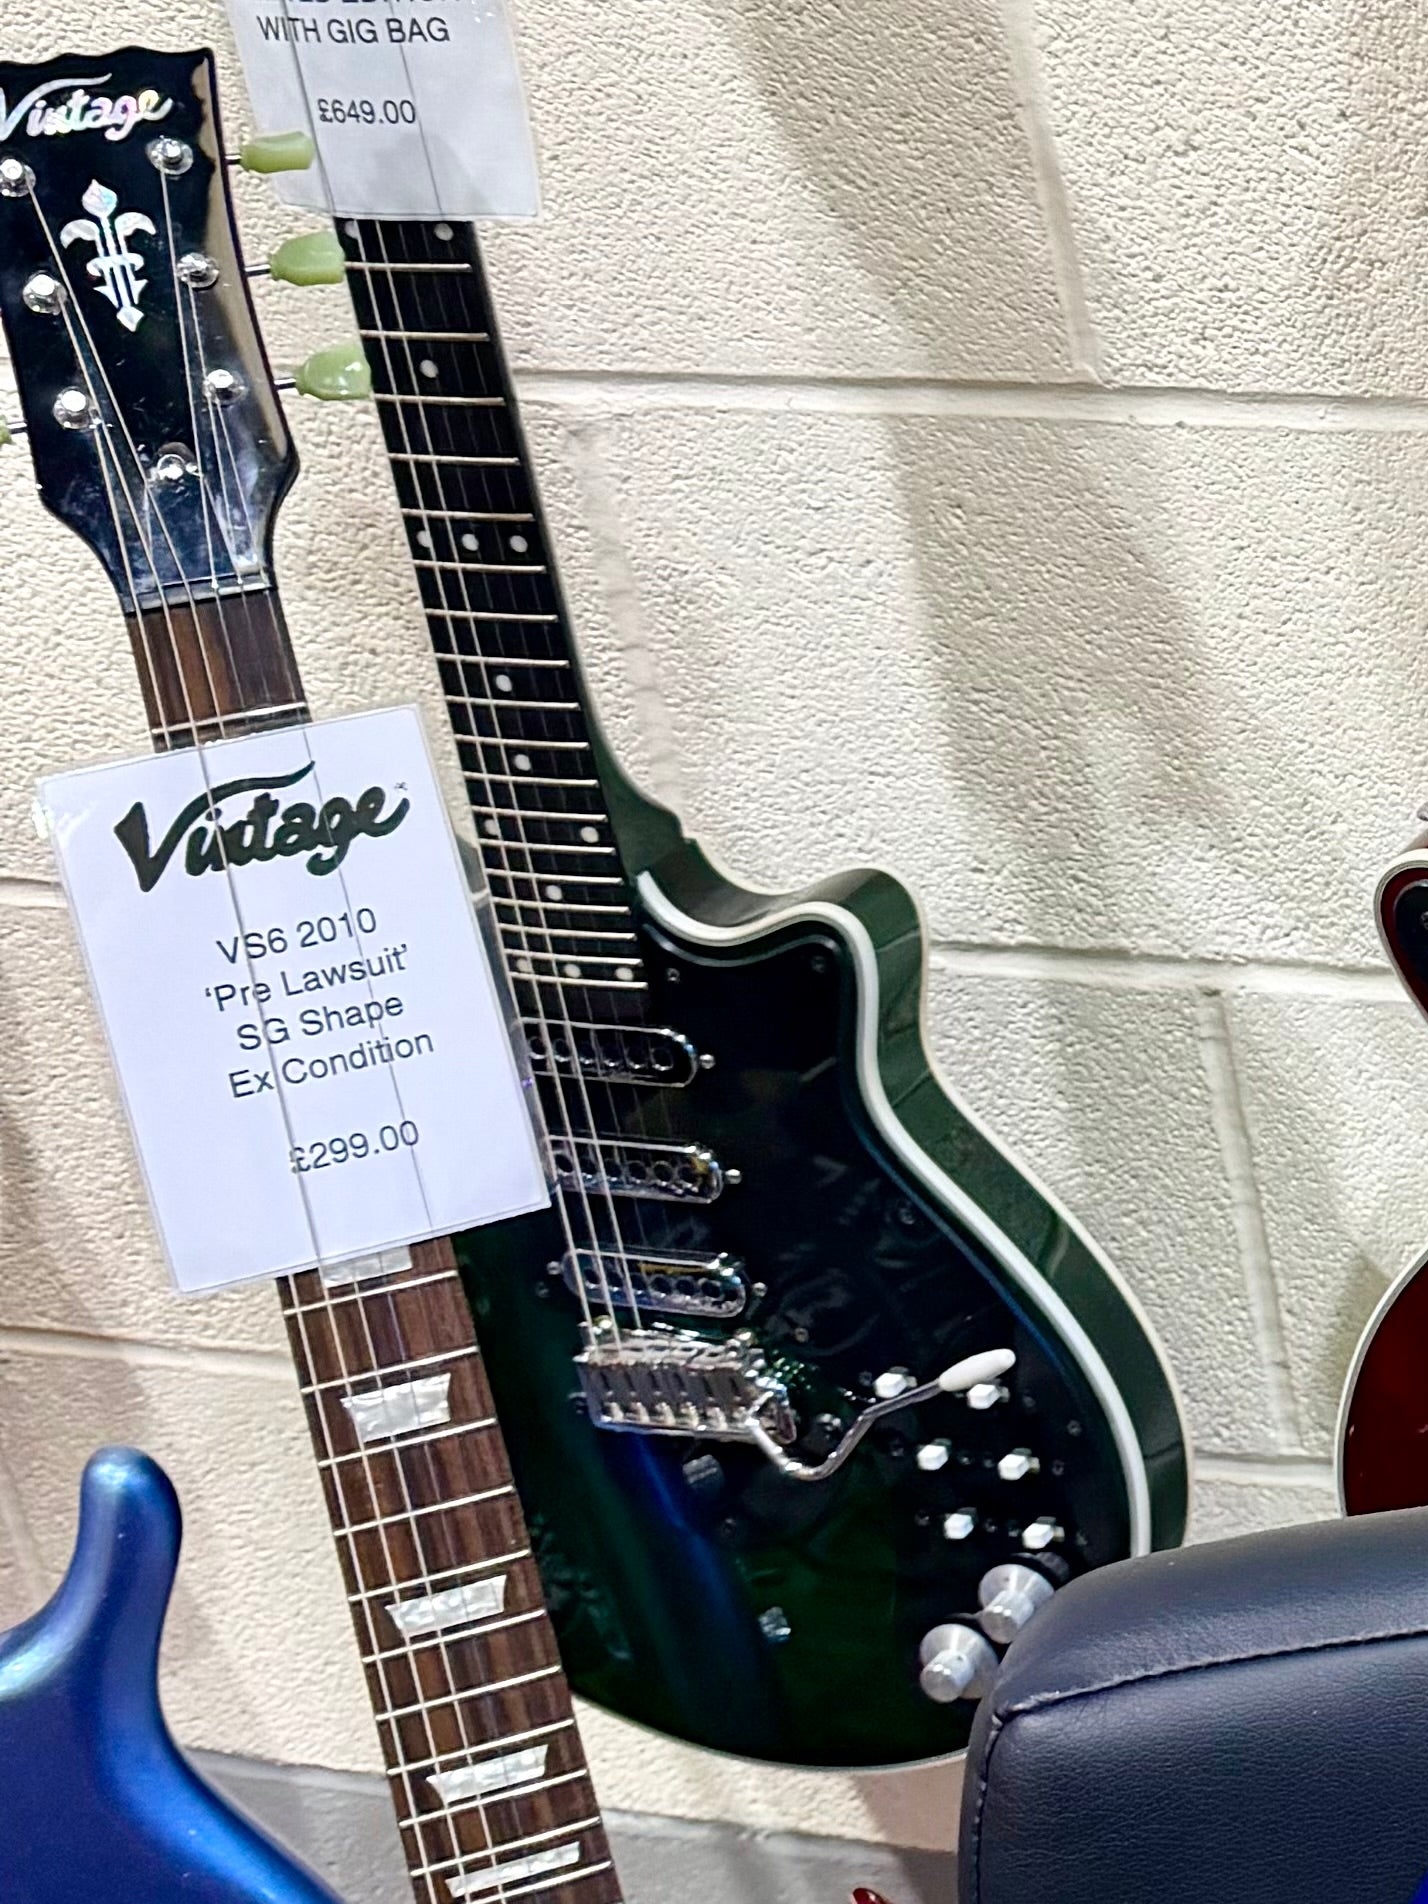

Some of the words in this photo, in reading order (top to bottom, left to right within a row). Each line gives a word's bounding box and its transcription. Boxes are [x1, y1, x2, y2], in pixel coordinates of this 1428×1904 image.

[256, 15, 322, 43] WITH
[327, 18, 379, 44] GIG
[386, 16, 451, 44] BAG
[318, 98, 417, 125] £649.00
[113, 761, 411, 893] Vintage
[216, 927, 288, 964] VS6
[296, 907, 377, 948] 2010
[237, 1017, 291, 1051] SG
[299, 996, 404, 1036] Shape
[228, 1069, 275, 1098] Ex
[281, 1033, 435, 1085] Condition
[289, 1120, 420, 1174] £299.00
